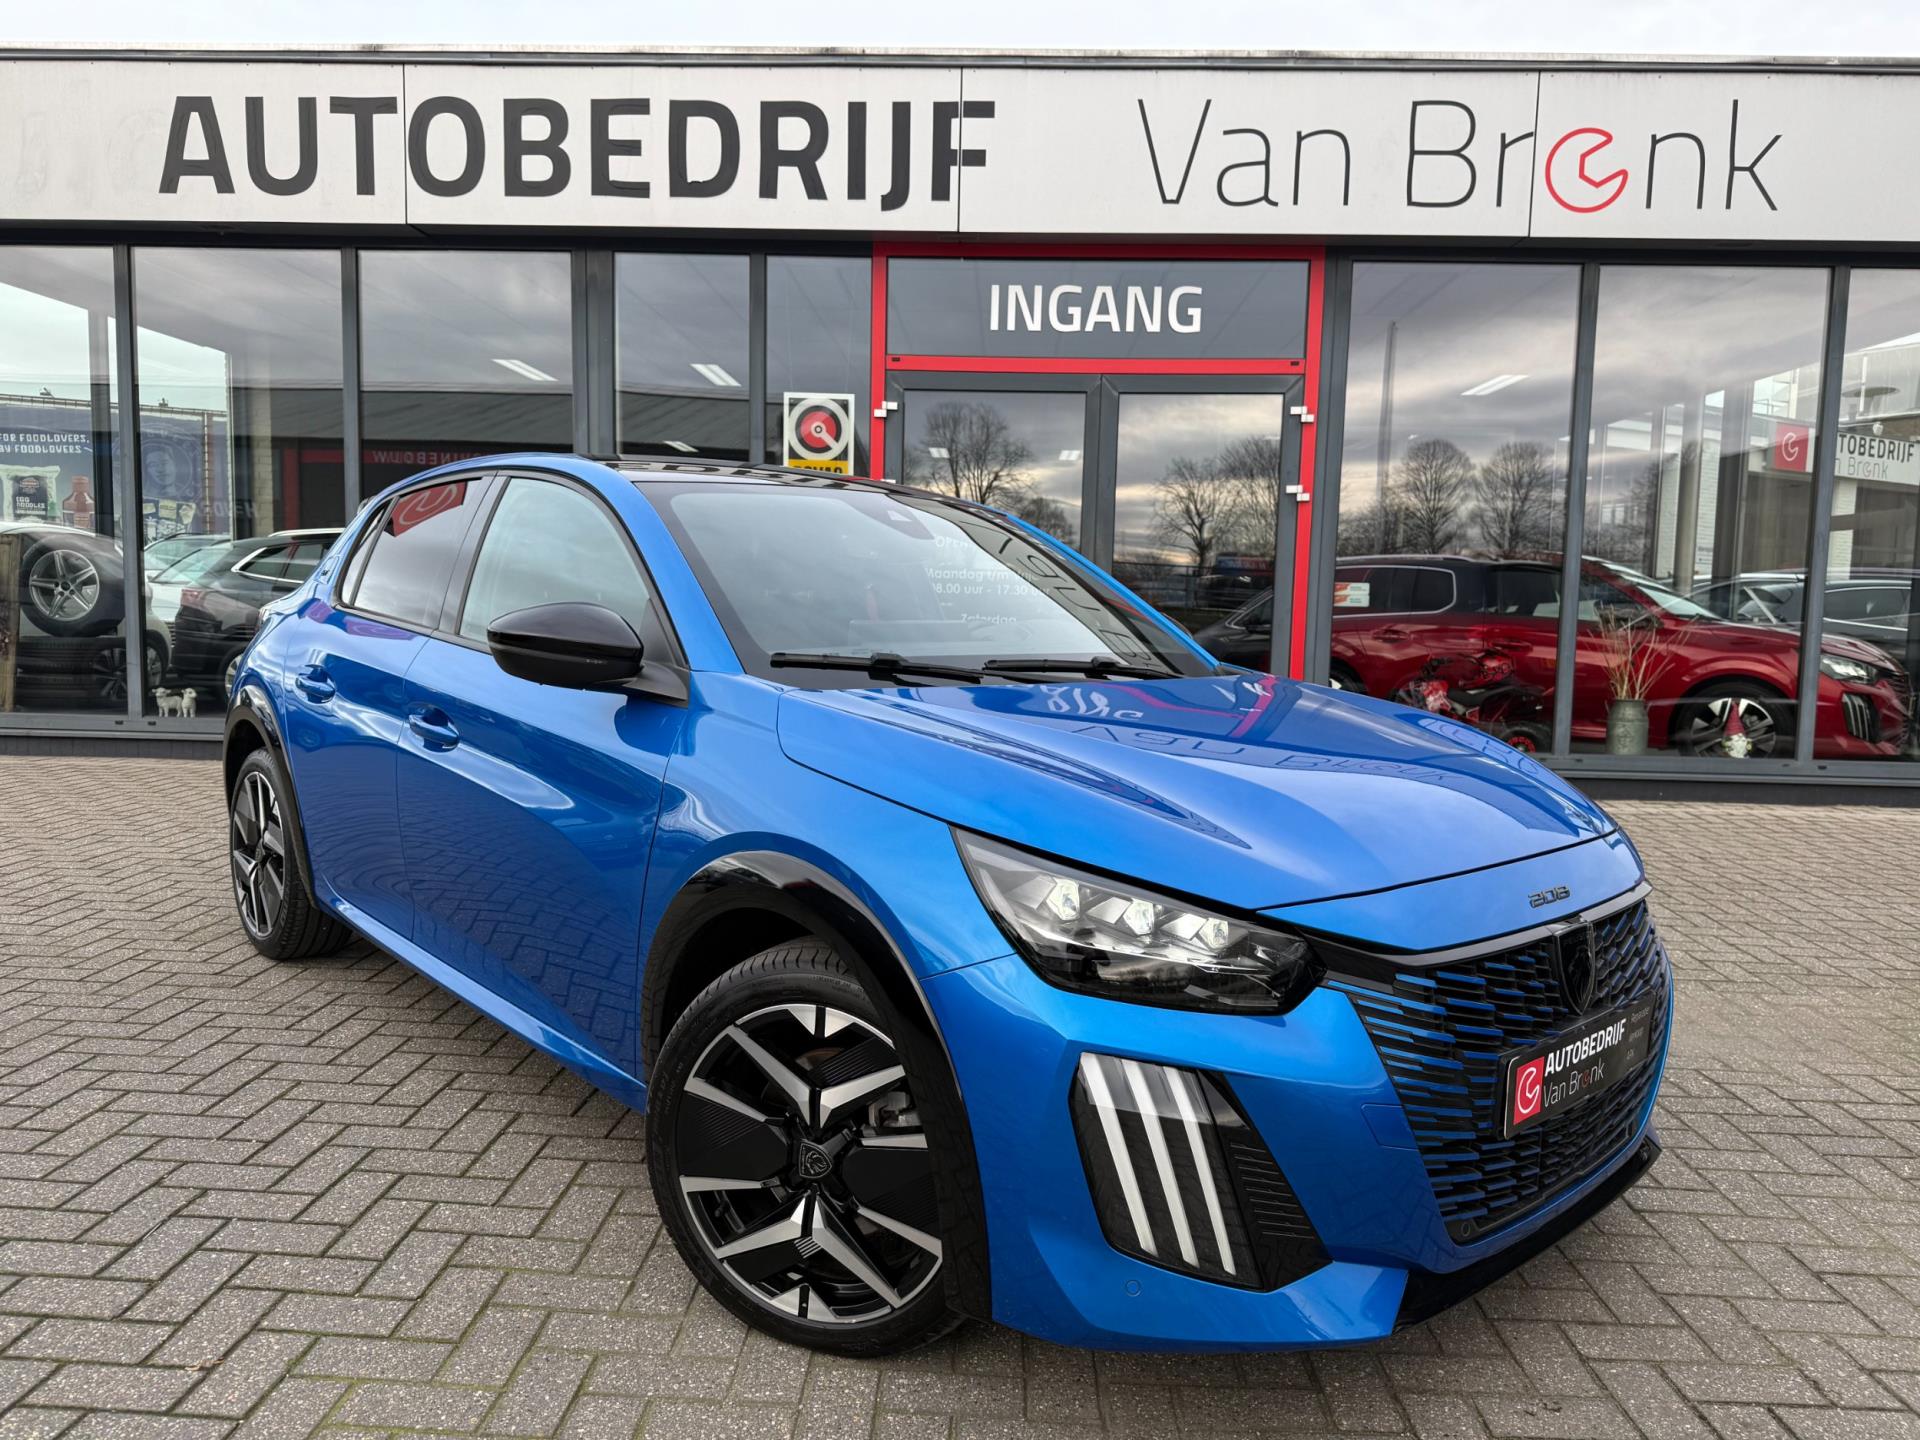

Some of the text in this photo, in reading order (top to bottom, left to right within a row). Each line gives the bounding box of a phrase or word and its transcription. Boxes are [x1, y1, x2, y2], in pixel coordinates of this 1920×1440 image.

[158, 96, 995, 211] AUTOBEDRIJF
[1138, 99, 1782, 213] Van Bronk
[989, 284, 1203, 334] INGANG
[14, 444, 82, 454] FOODLOVERS
[1838, 434, 1915, 463] TOBEDRIJF
[1528, 886, 1570, 908] 208
[1544, 1018, 1627, 1077] AUTOBEDRIJF
[1543, 1081, 1567, 1107] Van
